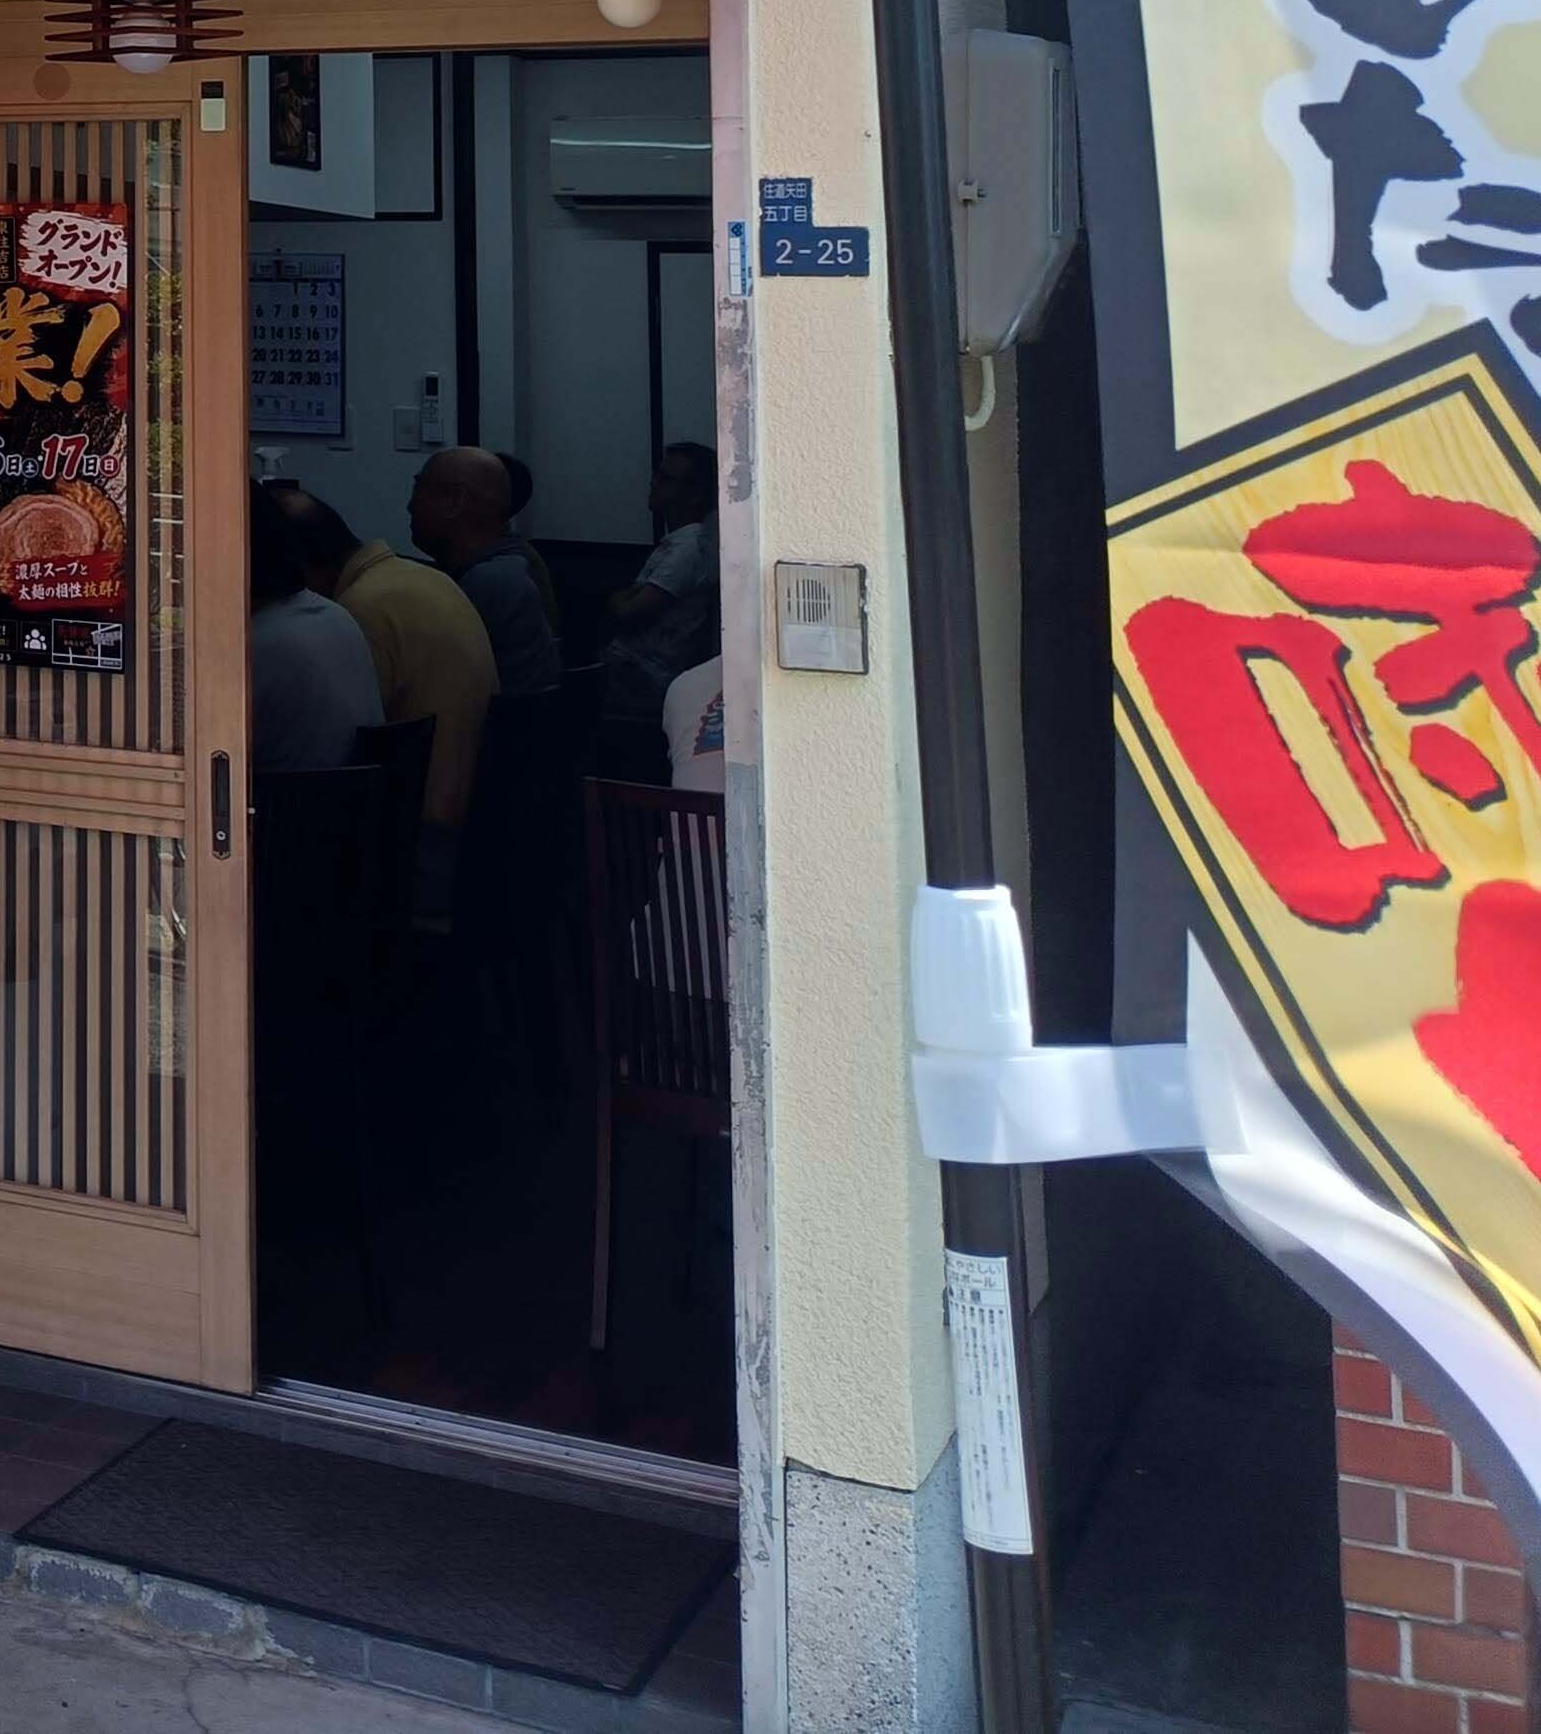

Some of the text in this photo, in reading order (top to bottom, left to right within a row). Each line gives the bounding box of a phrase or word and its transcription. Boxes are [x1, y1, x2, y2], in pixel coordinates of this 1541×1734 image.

[764, 206, 807, 222] 五丁目
[38, 219, 123, 256] グランド
[775, 239, 854, 265] 2-25
[38, 249, 122, 289] オープン!
[325, 305, 338, 318] 10
[253, 326, 338, 340] 13 14 15 16 17
[253, 349, 338, 363] 20 21 22 23 24
[253, 371, 338, 385] 27 28 29 30 31
